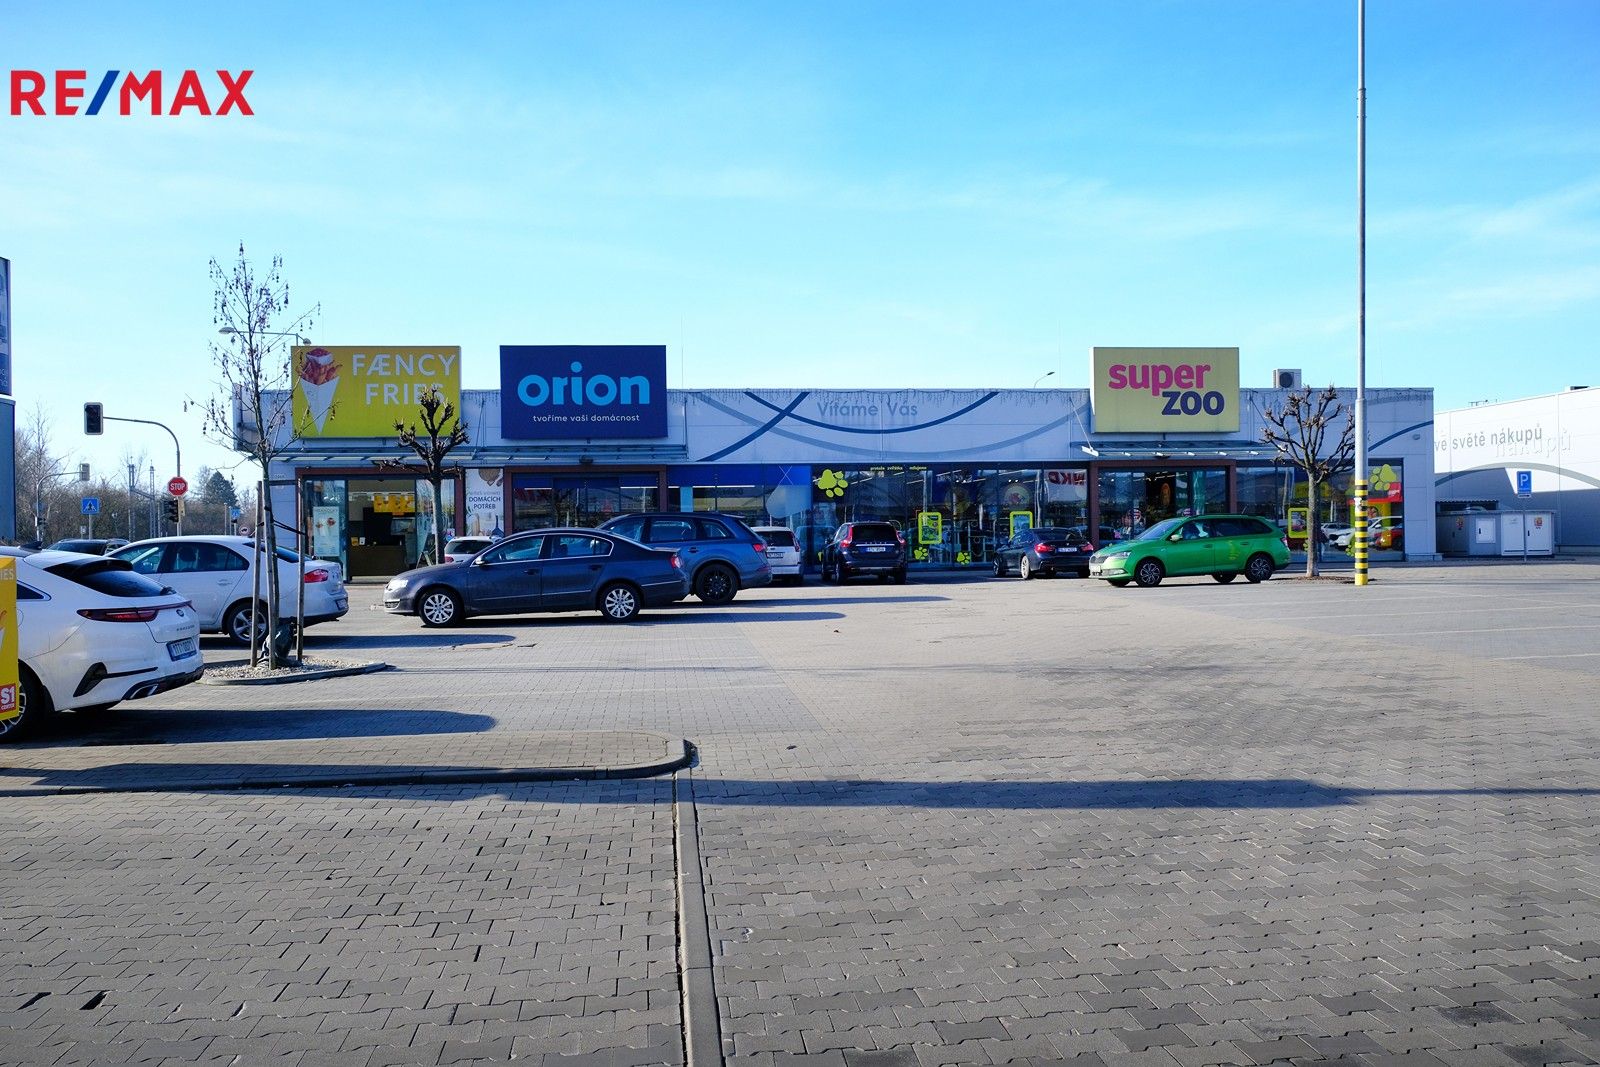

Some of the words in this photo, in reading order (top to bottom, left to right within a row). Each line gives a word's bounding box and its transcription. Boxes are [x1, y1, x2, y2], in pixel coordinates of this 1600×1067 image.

[352, 354, 456, 376] FÆNCY
[518, 361, 650, 407] orion
[1108, 364, 1211, 397] super
[366, 383, 445, 406] FRIES
[1161, 391, 1225, 416] zoo
[533, 414, 568, 423] tvoříme
[570, 414, 588, 423] vaši
[591, 413, 640, 423] domácnost
[817, 400, 879, 417] Vítáme
[887, 400, 918, 417] Vás
[1452, 431, 1486, 450] světě
[1490, 423, 1543, 446] nákupů
[170, 482, 186, 491] STOP
[1520, 473, 1529, 487] P
[468, 495, 501, 503] DOMÁCÍCH
